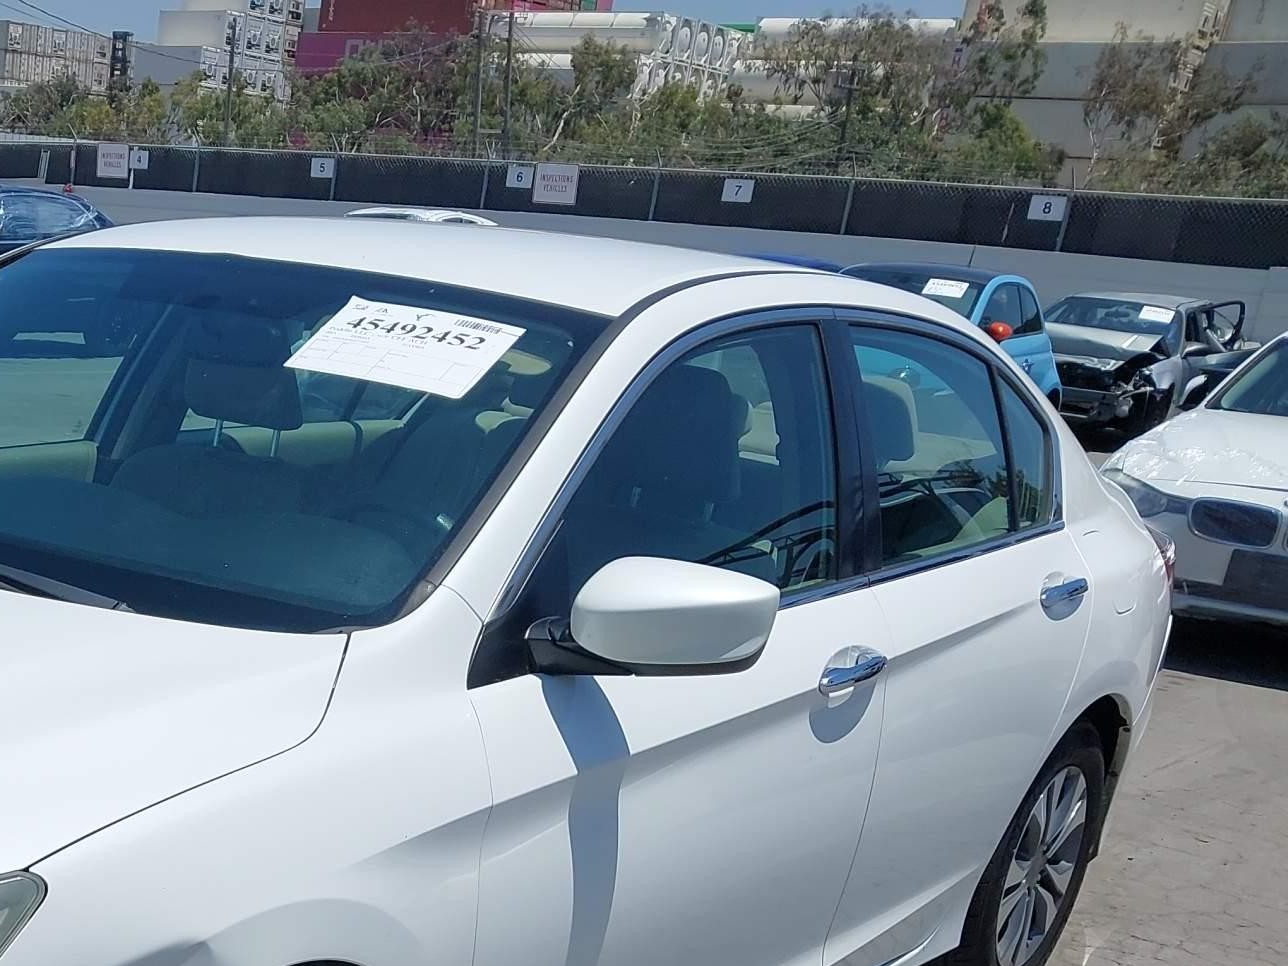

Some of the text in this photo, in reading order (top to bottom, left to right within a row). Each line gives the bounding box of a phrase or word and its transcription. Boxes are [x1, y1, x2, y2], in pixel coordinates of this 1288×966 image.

[136, 155, 142, 164] 4
[319, 162, 326, 173] 5
[516, 171, 524, 183] 6
[735, 184, 743, 197] 7
[1042, 201, 1053, 215] 8
[346, 316, 486, 350] 45492452
